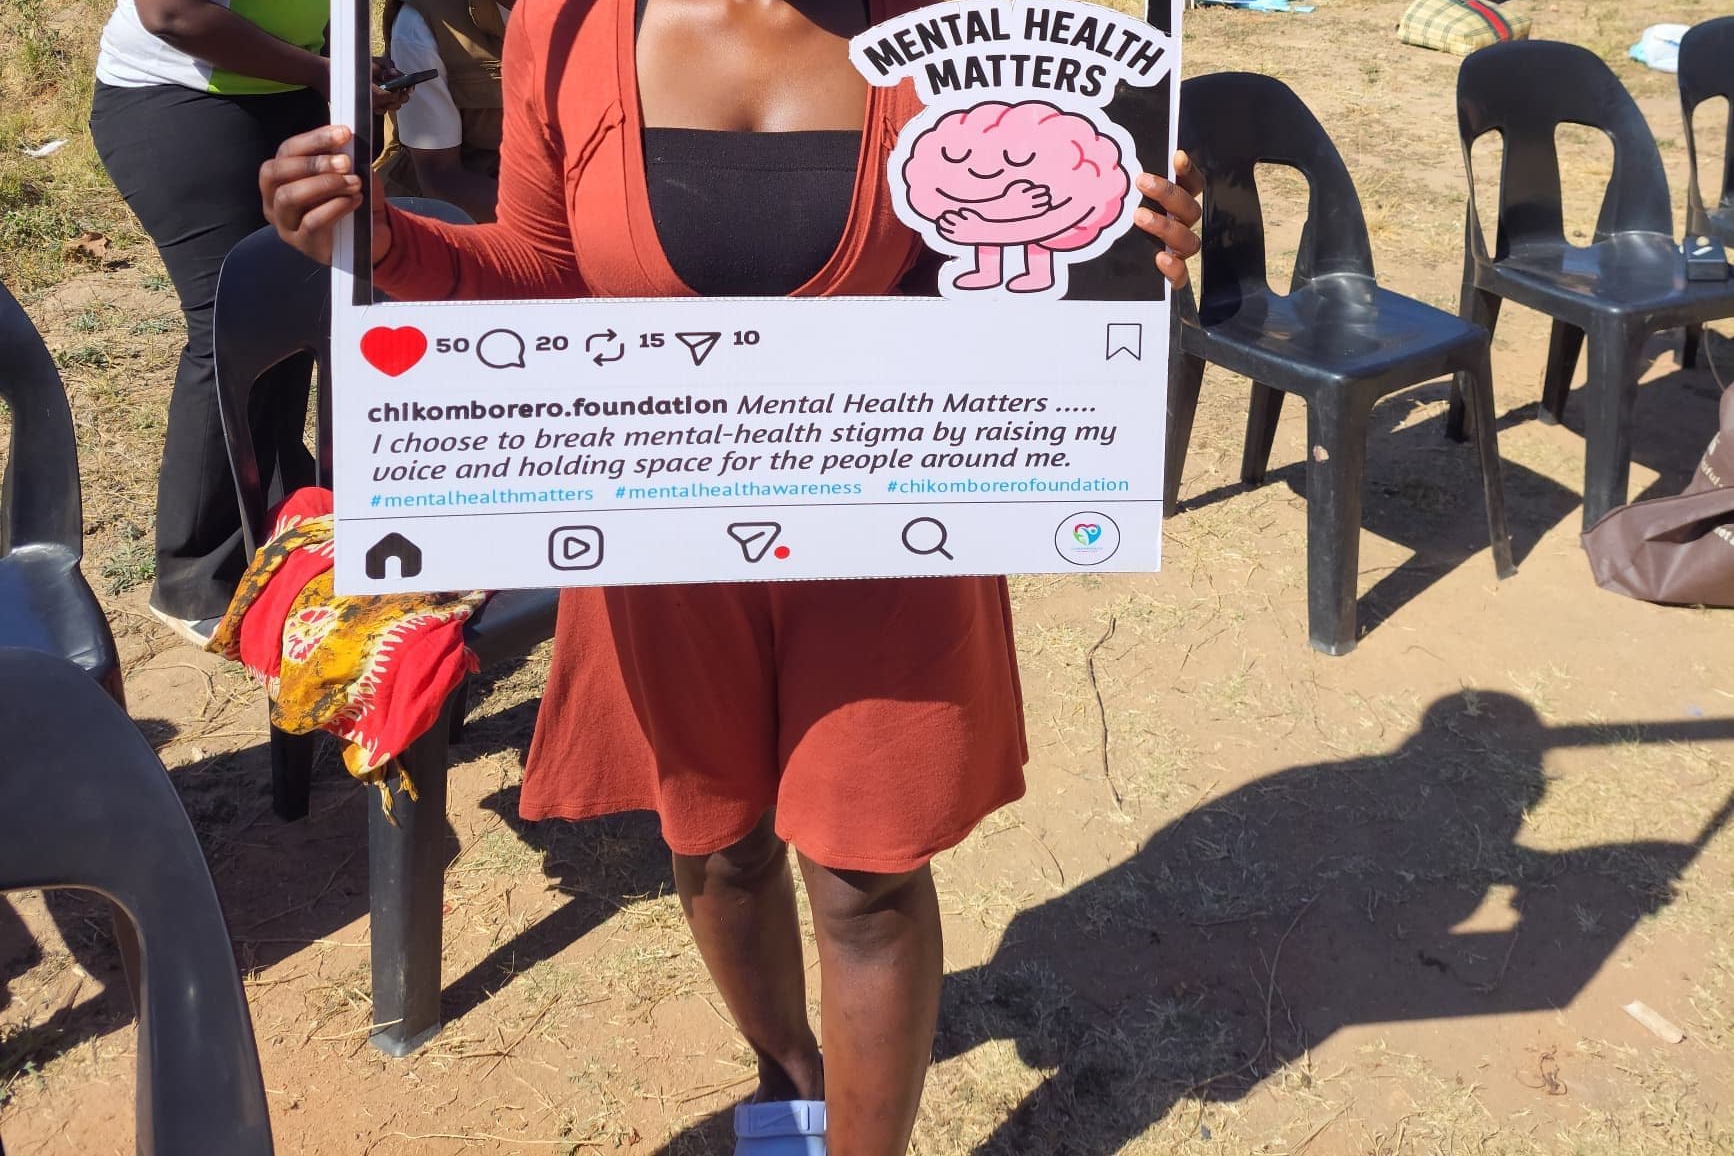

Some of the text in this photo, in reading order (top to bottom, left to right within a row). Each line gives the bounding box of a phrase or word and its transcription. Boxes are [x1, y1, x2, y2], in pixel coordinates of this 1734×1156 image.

[863, 7, 1166, 77] MENTAL HEALTH
[925, 54, 1107, 96] MATTERS
[436, 330, 760, 353] 50 20 15 10
[367, 395, 728, 423] chikomborero.foundation
[736, 393, 834, 415] Mental
[843, 392, 934, 414] Health
[942, 392, 1049, 413] Matters
[372, 420, 1117, 454] I choose to break mental-health stigma by raising my
[373, 447, 1071, 483] voice and holding space for the people around me.
[370, 476, 1129, 508] #mentalhealthmatters #mentalhealthawareness #chikomborerofoundation
